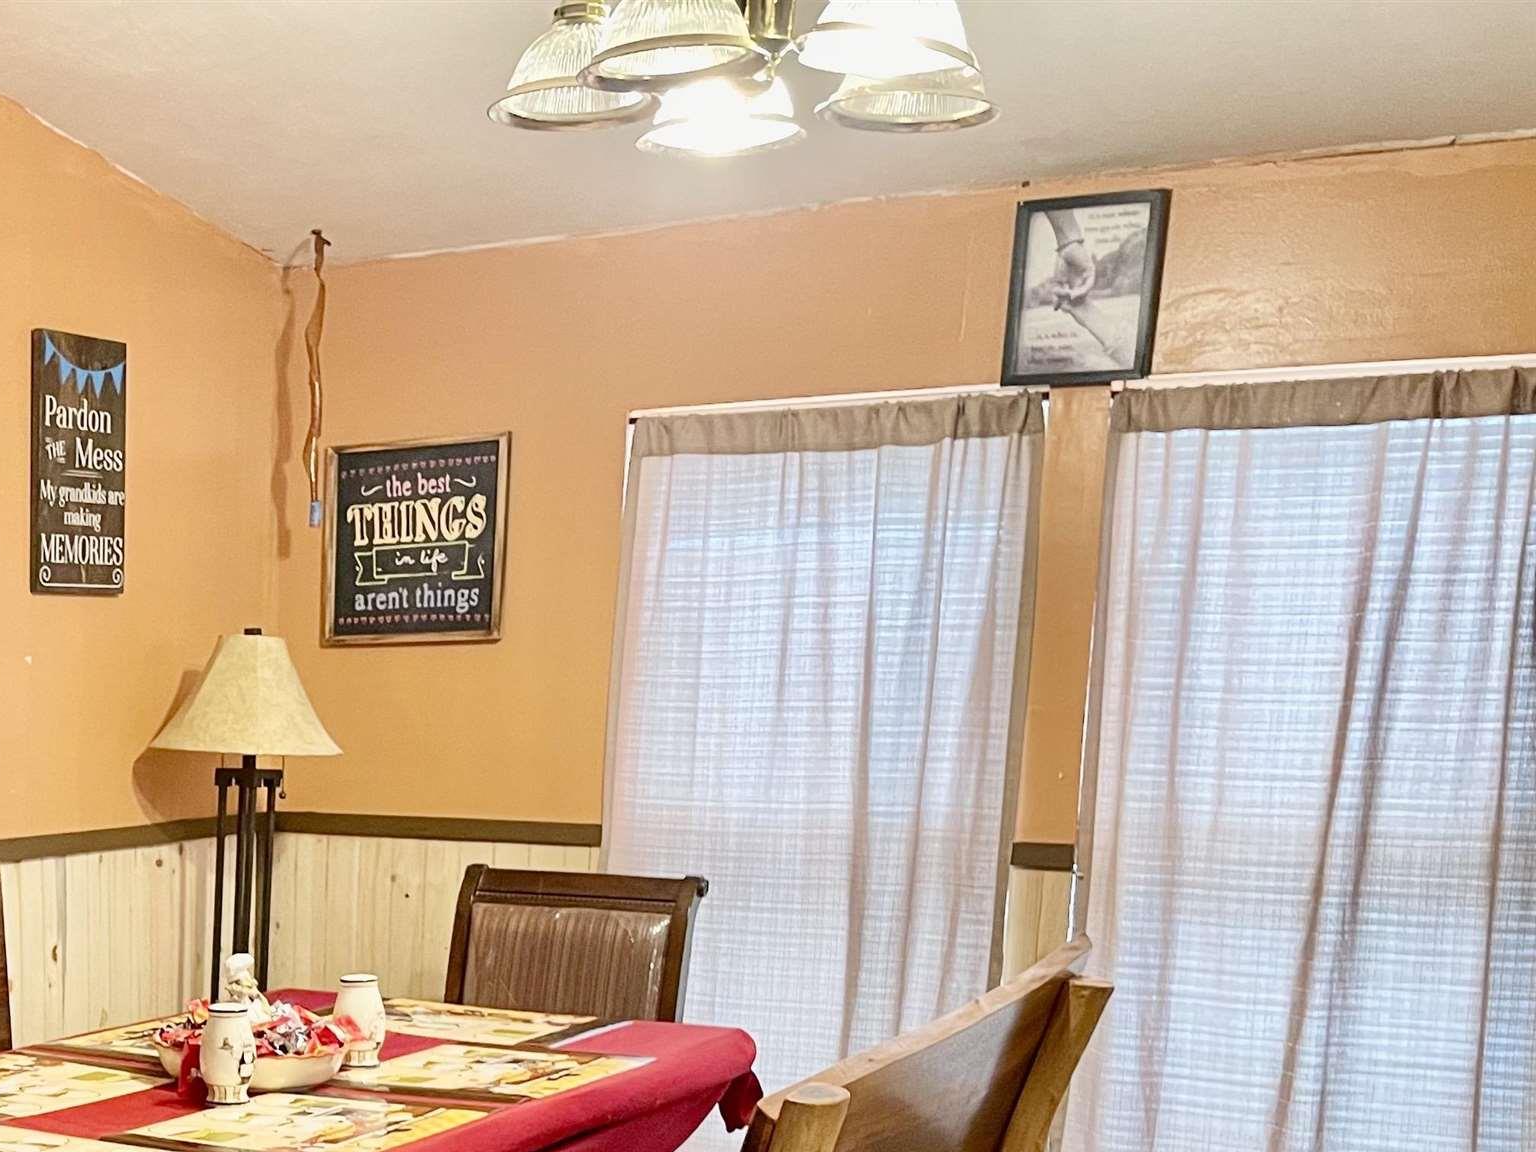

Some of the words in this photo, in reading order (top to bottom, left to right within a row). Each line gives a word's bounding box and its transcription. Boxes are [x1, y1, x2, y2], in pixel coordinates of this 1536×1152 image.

[44, 394, 112, 435] Pardon
[45, 439, 66, 463] THE
[75, 436, 123, 472] Mess
[40, 479, 58, 506] My
[59, 481, 107, 507] grandkids
[109, 490, 125, 505] are
[386, 474, 412, 498] the
[417, 472, 451, 494] best
[64, 507, 102, 532] making
[346, 493, 487, 547] THINGS
[40, 533, 123, 566] MEMORIES
[395, 551, 415, 566] in
[420, 549, 449, 572] life
[354, 587, 410, 611] aren't
[416, 583, 479, 613] things
